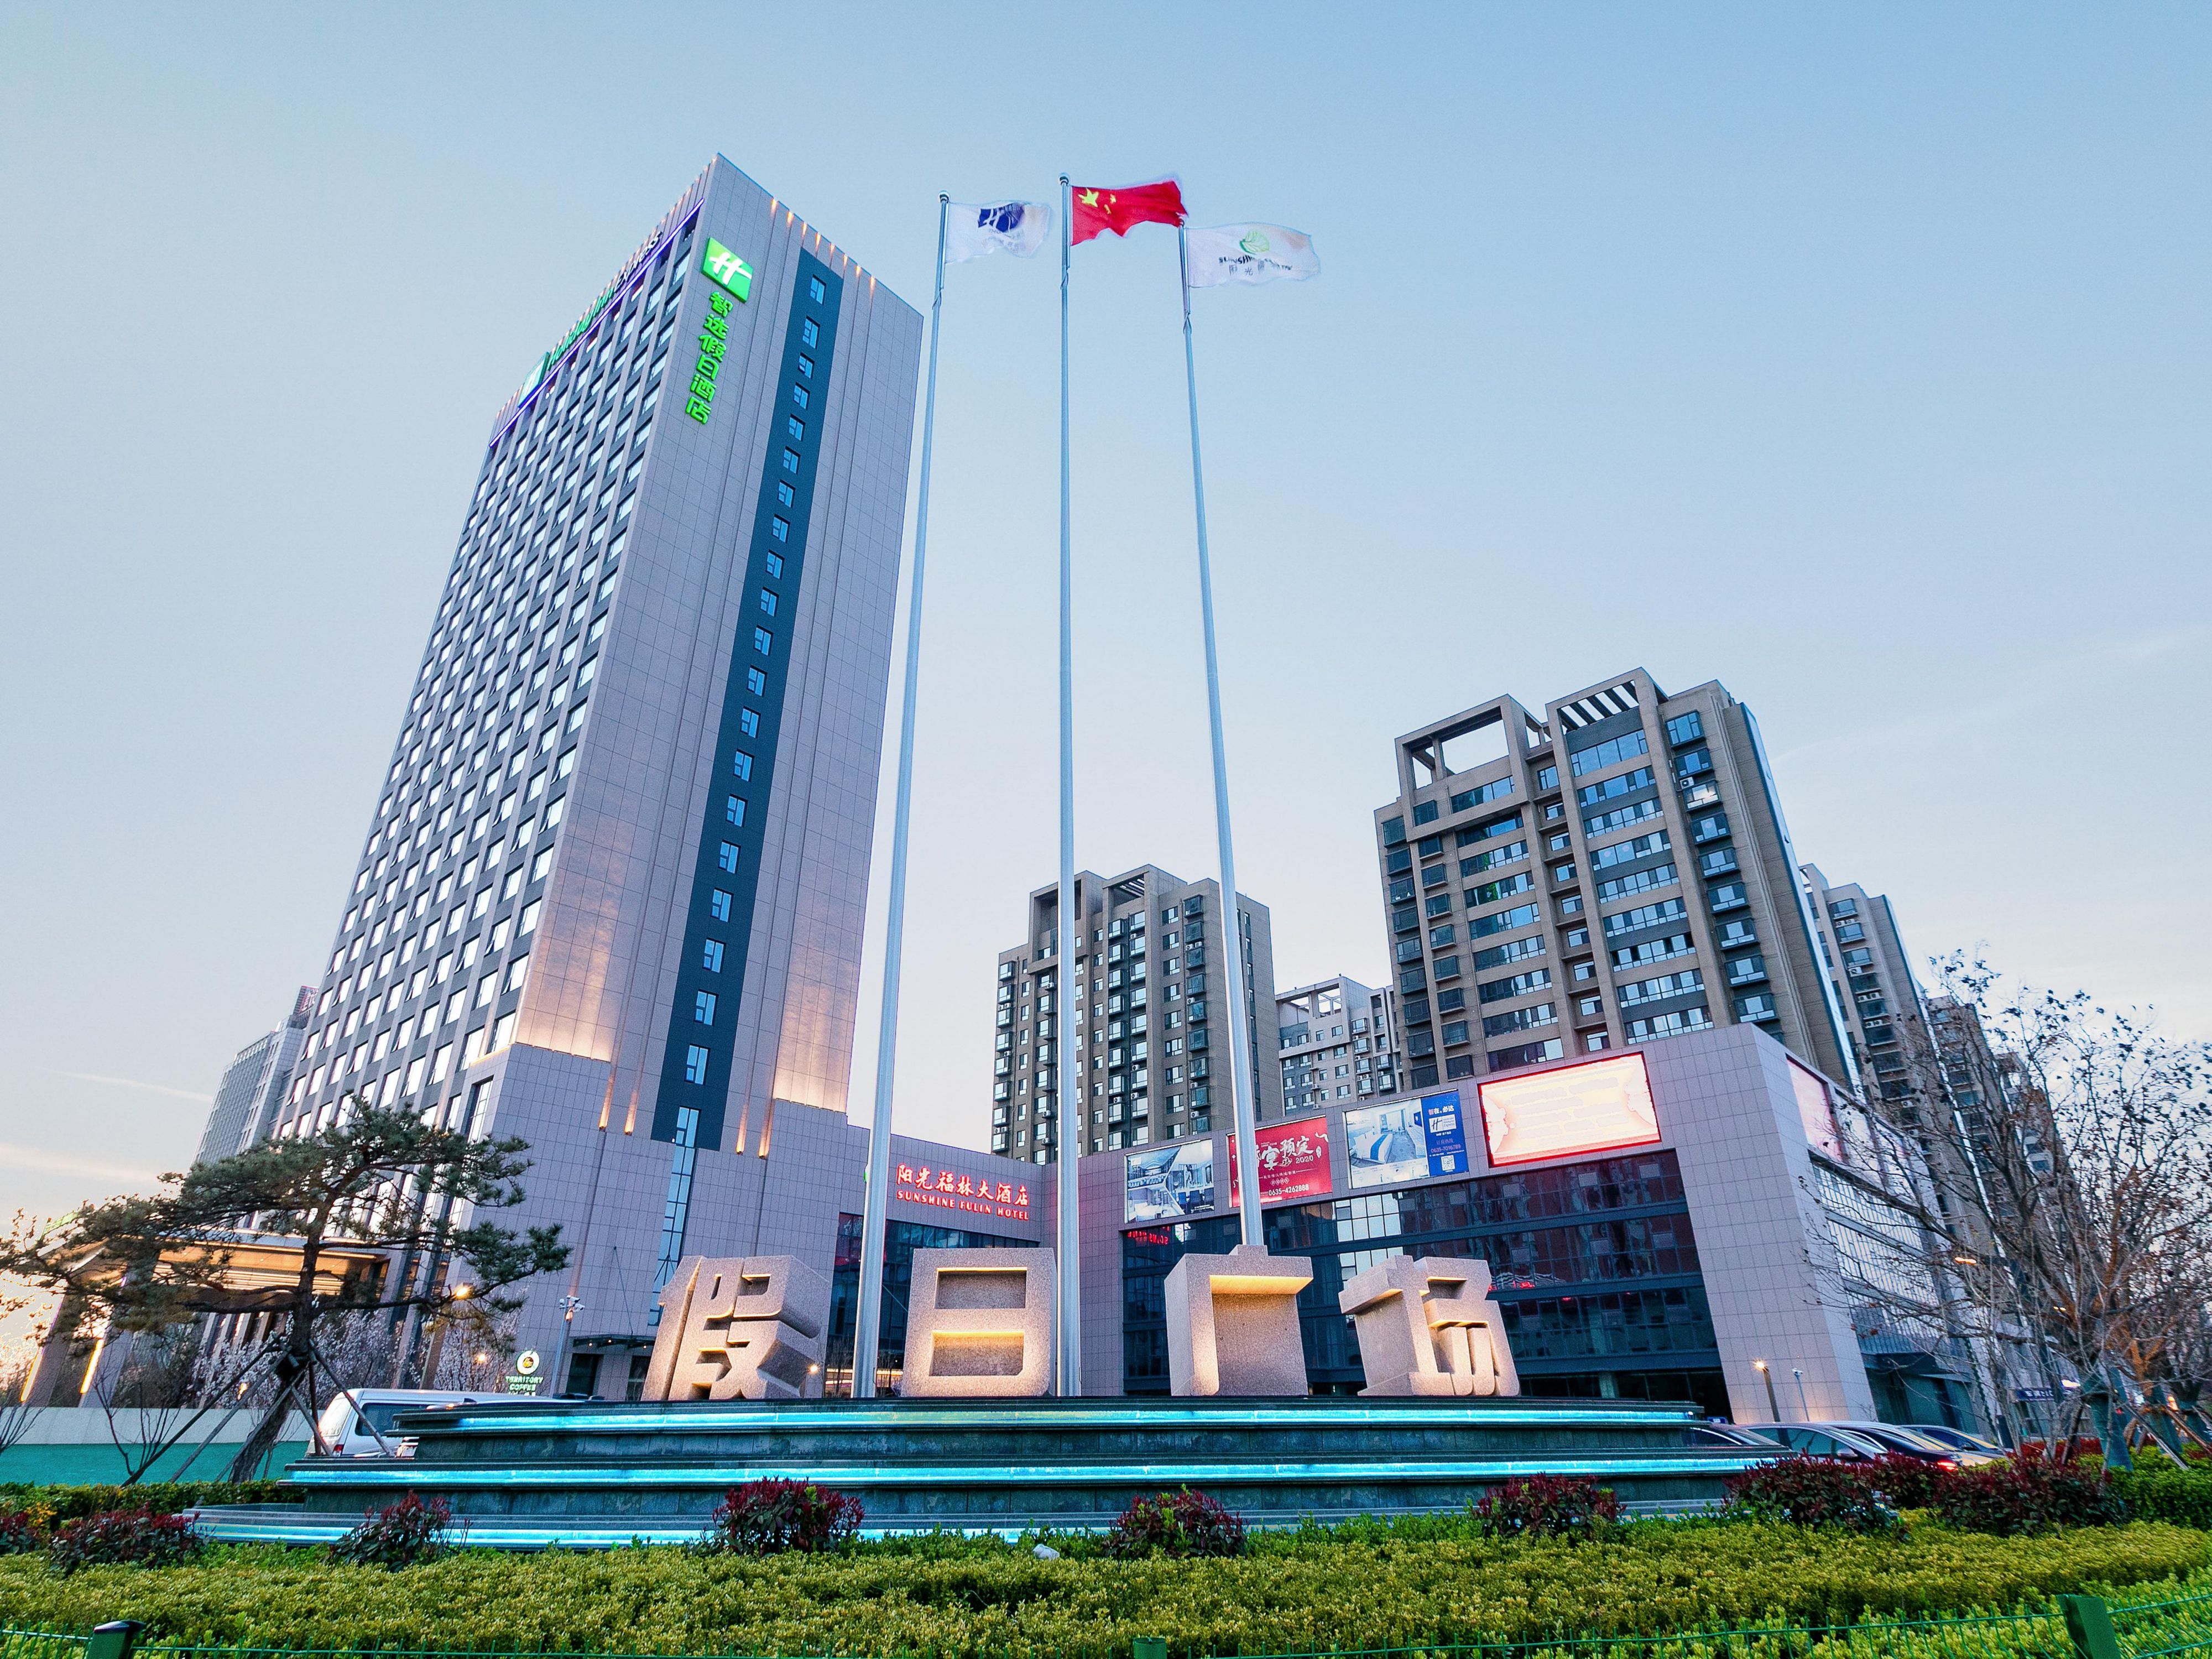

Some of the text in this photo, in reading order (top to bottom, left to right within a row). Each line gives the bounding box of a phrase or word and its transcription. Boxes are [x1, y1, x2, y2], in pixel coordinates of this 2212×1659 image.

[685, 291, 734, 425] 智选假日酒店
[896, 1163, 1029, 1206] 阳光福林大酒店
[896, 1189, 1029, 1220] SUNSHINE FULIN HOTEL
[1269, 1184, 1310, 1196] 0635-4262888
[641, 1244, 1521, 1398] 假日广场
